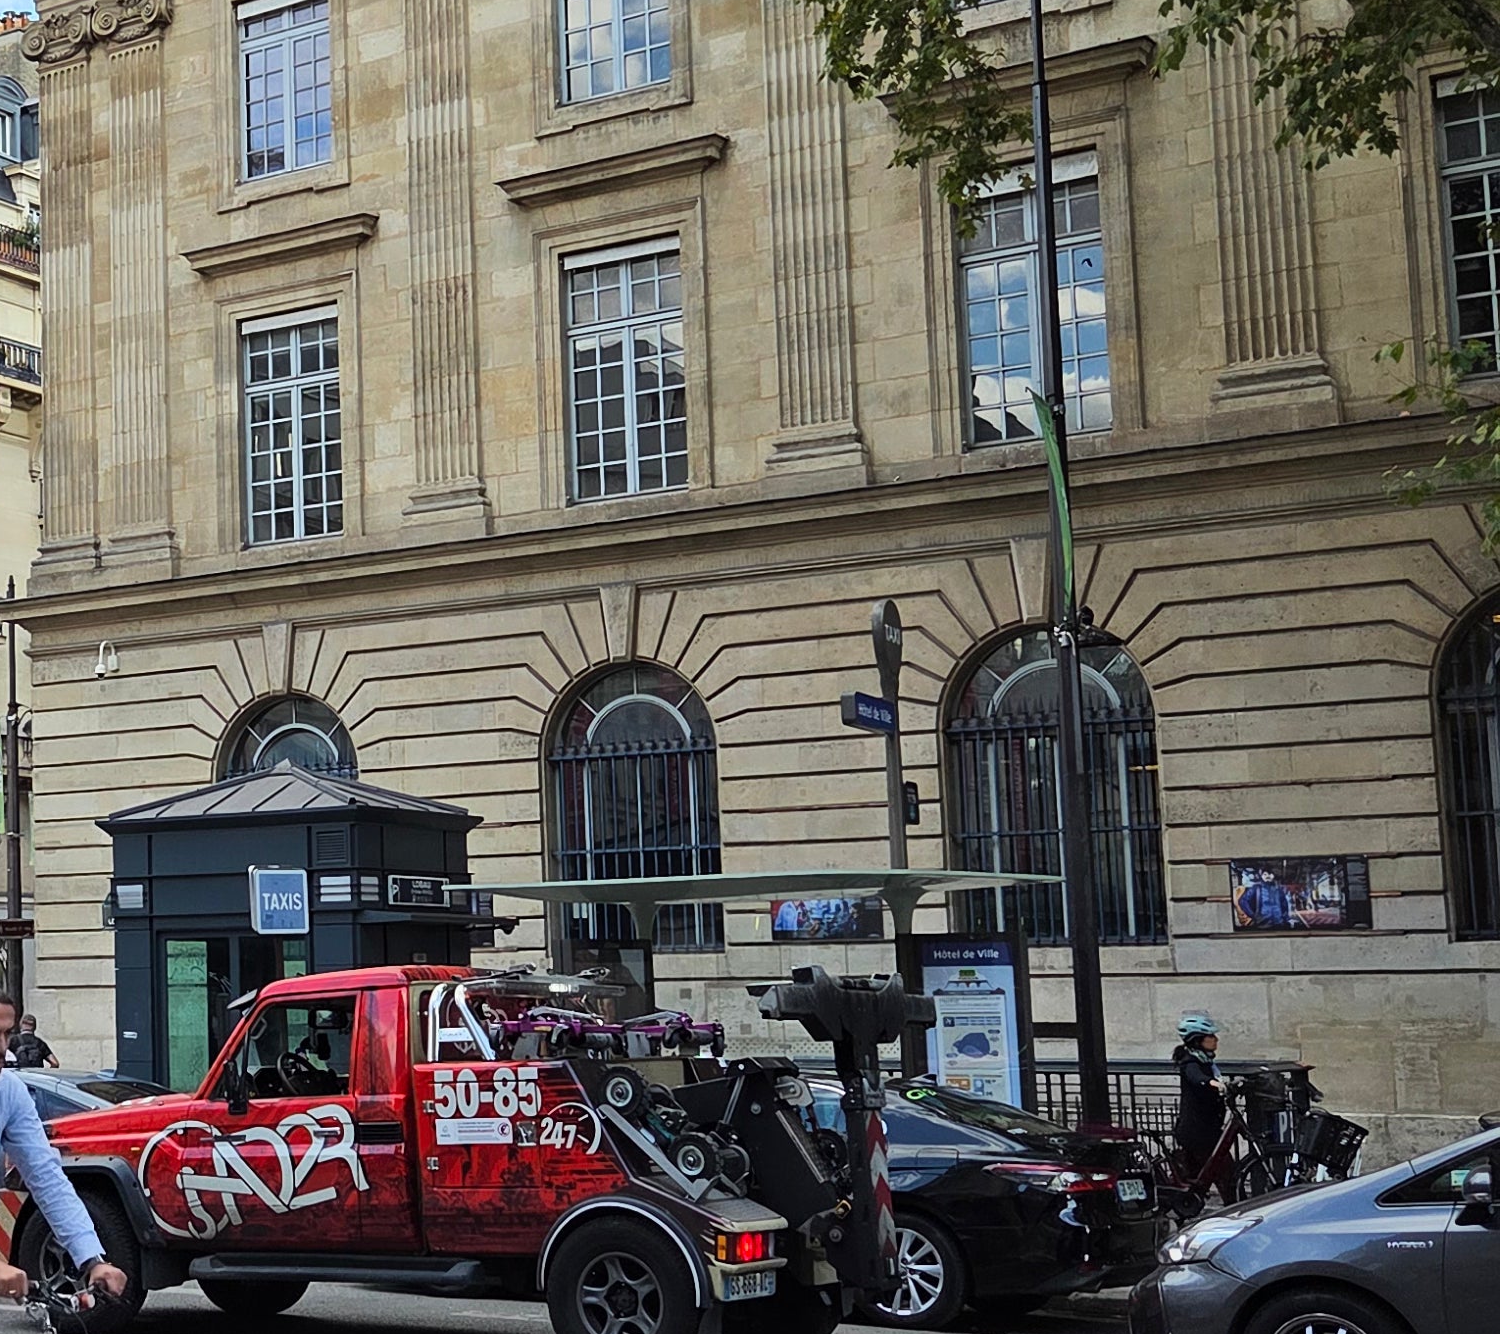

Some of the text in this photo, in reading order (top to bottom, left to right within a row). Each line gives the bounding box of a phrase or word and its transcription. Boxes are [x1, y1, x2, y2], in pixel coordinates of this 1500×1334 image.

[262, 892, 303, 911] TAXIS
[933, 948, 999, 959] Hôtel de Ville
[433, 1067, 542, 1118] 50-85
[540, 1117, 577, 1149] 247
